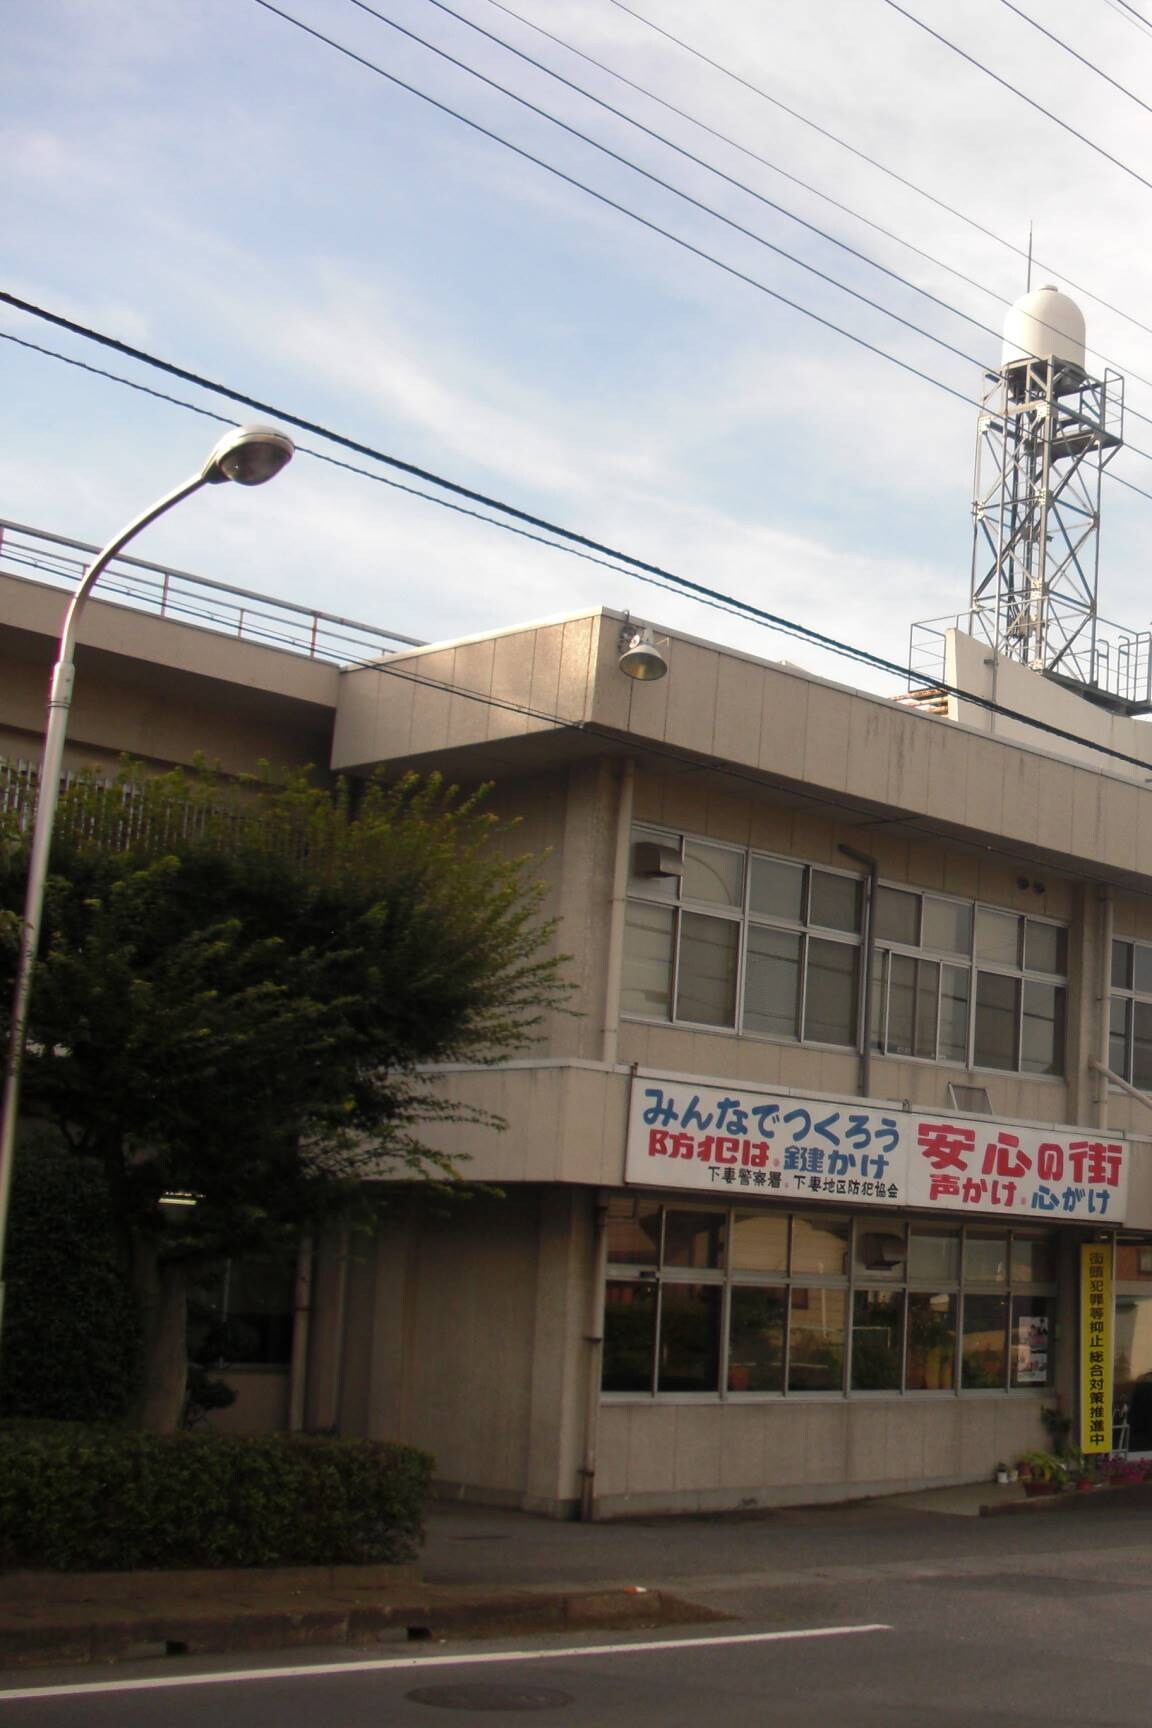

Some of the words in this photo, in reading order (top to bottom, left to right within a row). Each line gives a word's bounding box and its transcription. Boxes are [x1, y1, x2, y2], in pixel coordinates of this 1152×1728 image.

[642, 1088, 901, 1153] みんなでつくろう
[917, 1122, 1123, 1187] 安心の街
